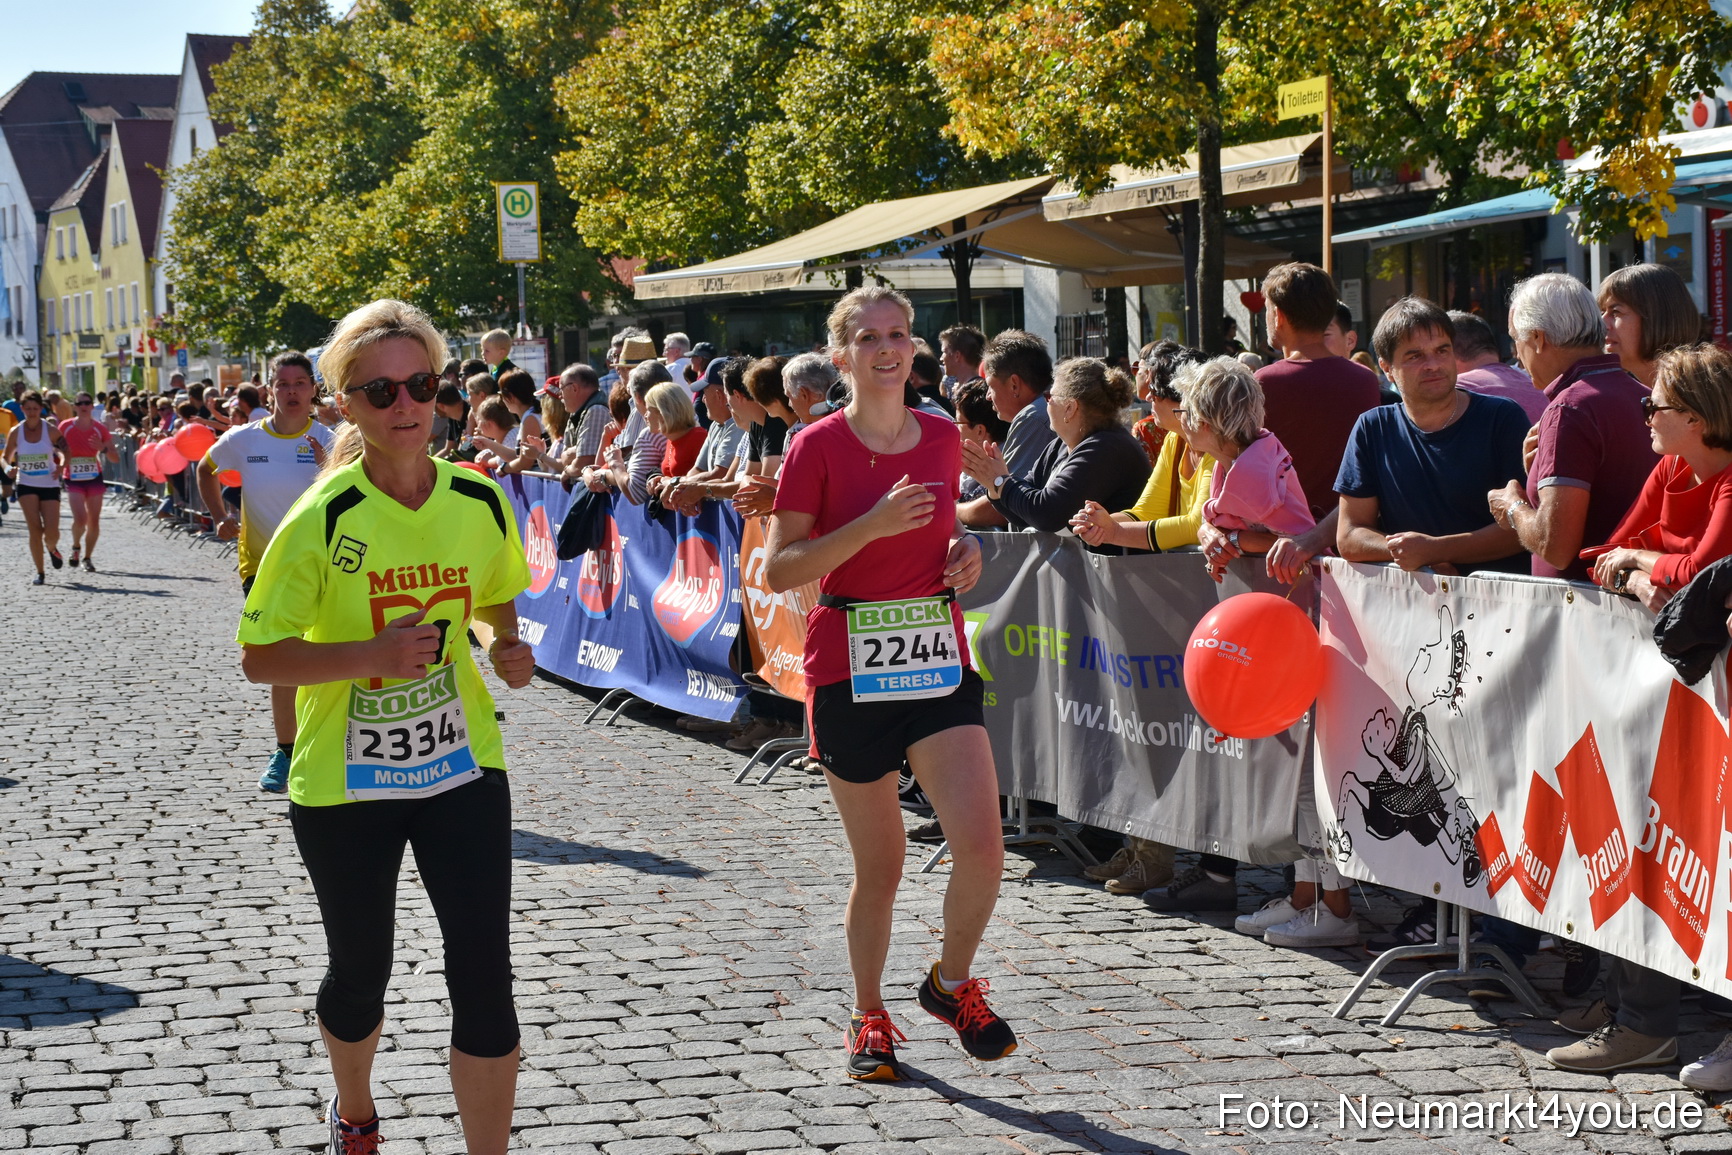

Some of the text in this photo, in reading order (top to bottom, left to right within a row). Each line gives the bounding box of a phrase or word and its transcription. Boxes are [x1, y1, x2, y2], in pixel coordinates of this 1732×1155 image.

[1287, 90, 1324, 108] Toiletten
[511, 195, 525, 211] H
[1713, 228, 1723, 335] Business Store
[22, 461, 46, 470] 2760
[73, 464, 95, 473] 2287
[526, 522, 556, 577] Hervis
[366, 562, 469, 595] Müller
[657, 559, 720, 621] Hervis
[856, 601, 945, 629] BOCK
[863, 632, 949, 668] 2244
[1217, 651, 1250, 667] energie
[354, 672, 452, 719] BOCK
[876, 672, 944, 690] TERESA
[359, 711, 457, 761] 2334
[374, 760, 453, 786] MONIKA
[1517, 829, 1552, 890] Braun
[1580, 827, 1626, 897] Braun
[1635, 796, 1710, 915] Braun
[1604, 879, 1619, 897] Sicher
[1663, 880, 1680, 910] Sicher
[1679, 902, 1689, 920] ist
